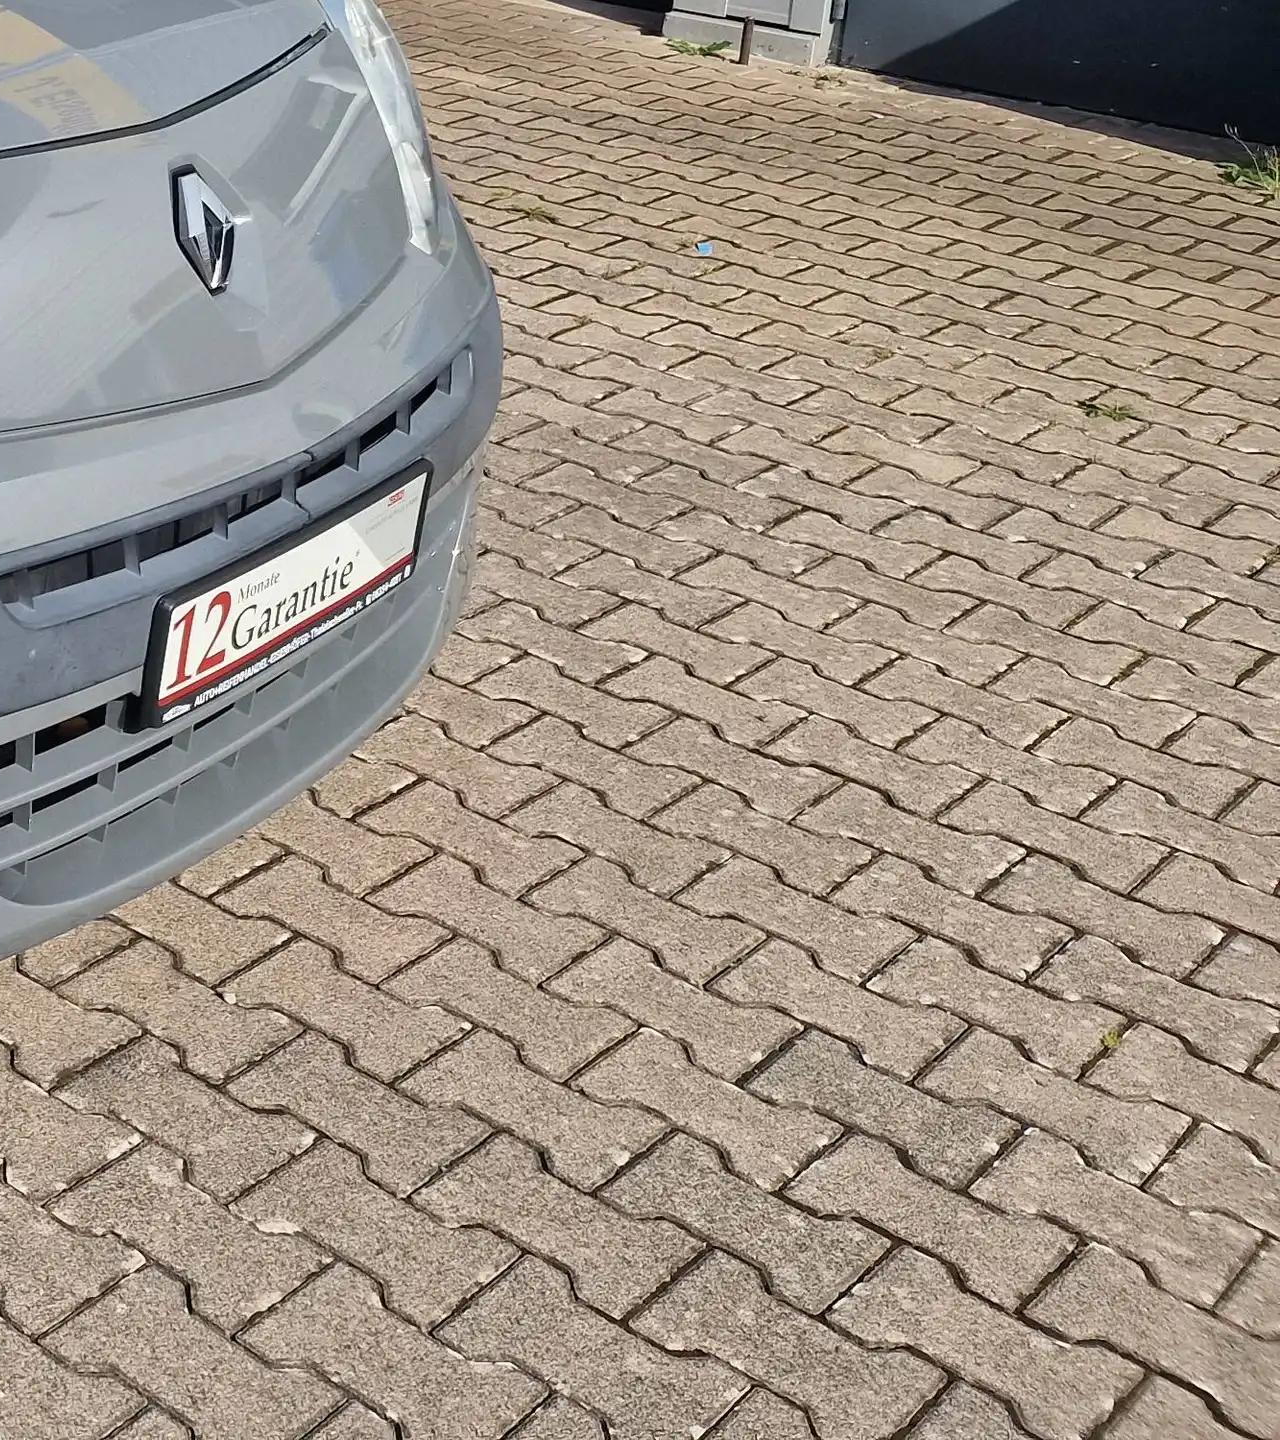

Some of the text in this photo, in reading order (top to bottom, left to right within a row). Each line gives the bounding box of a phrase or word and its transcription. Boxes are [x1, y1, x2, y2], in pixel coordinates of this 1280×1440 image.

[231, 556, 354, 650] Garantie
[237, 571, 281, 604] Monate
[166, 590, 232, 691] 12
